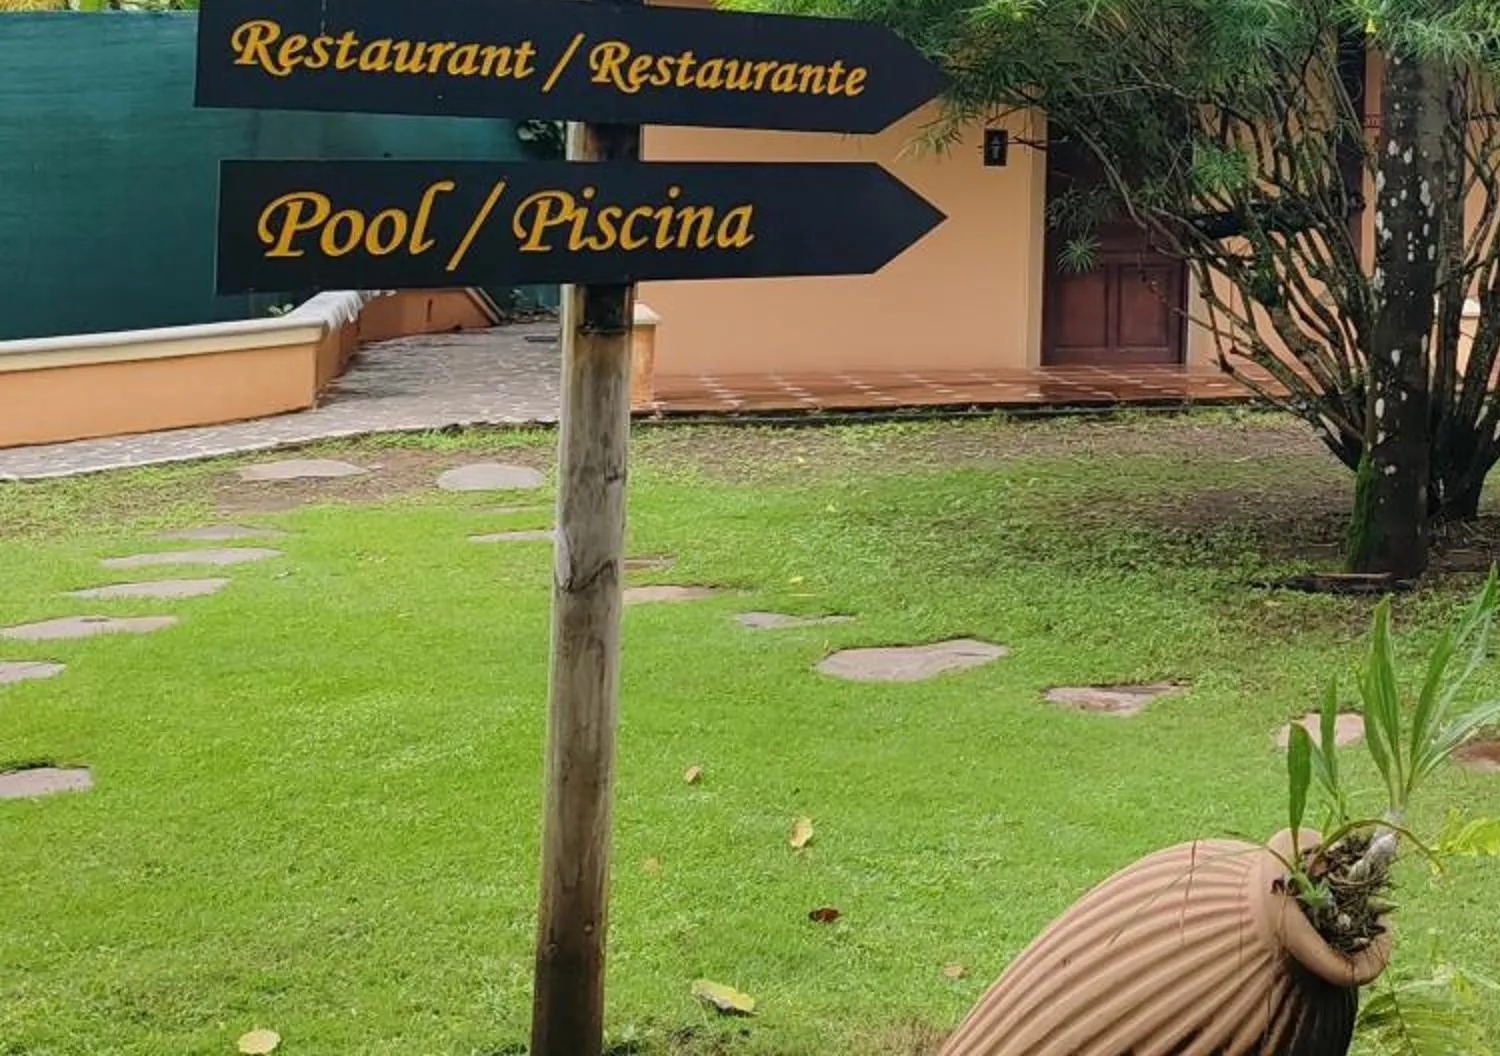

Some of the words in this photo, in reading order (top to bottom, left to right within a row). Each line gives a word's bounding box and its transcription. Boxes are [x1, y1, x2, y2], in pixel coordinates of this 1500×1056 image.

[231, 19, 535, 79] Restaurant
[542, 32, 584, 93] /
[589, 40, 867, 96] Restaurante
[257, 180, 455, 258] Pool
[446, 182, 506, 271] /
[512, 186, 754, 252] Piscina
